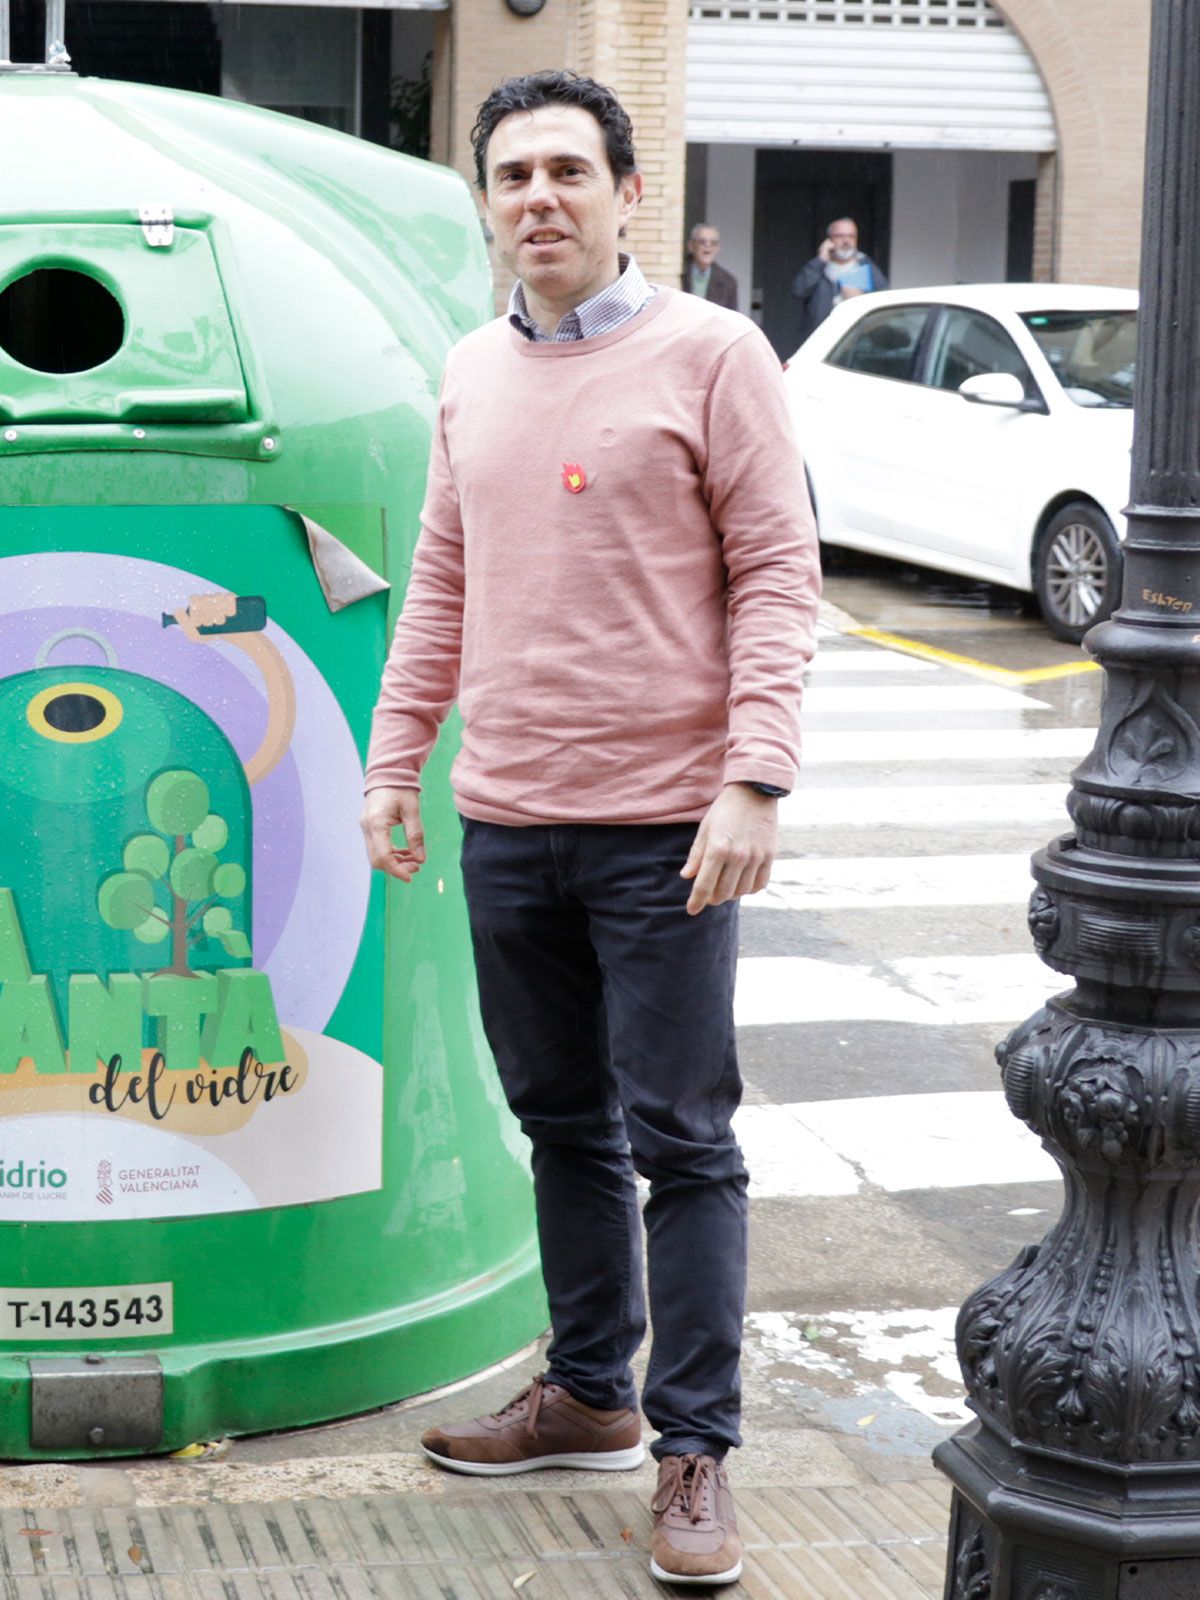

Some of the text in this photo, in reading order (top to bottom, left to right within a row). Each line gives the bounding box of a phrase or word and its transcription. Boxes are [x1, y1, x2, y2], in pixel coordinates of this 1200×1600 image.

[89, 1046, 299, 1120] del vidre
[119, 1165, 200, 1181] GENERALITAT
[119, 1179, 200, 1193] VALENCIANA
[23, 1191, 35, 1200] DE
[37, 1191, 68, 1201] LUCRE
[7, 1295, 163, 1328] T-143543
